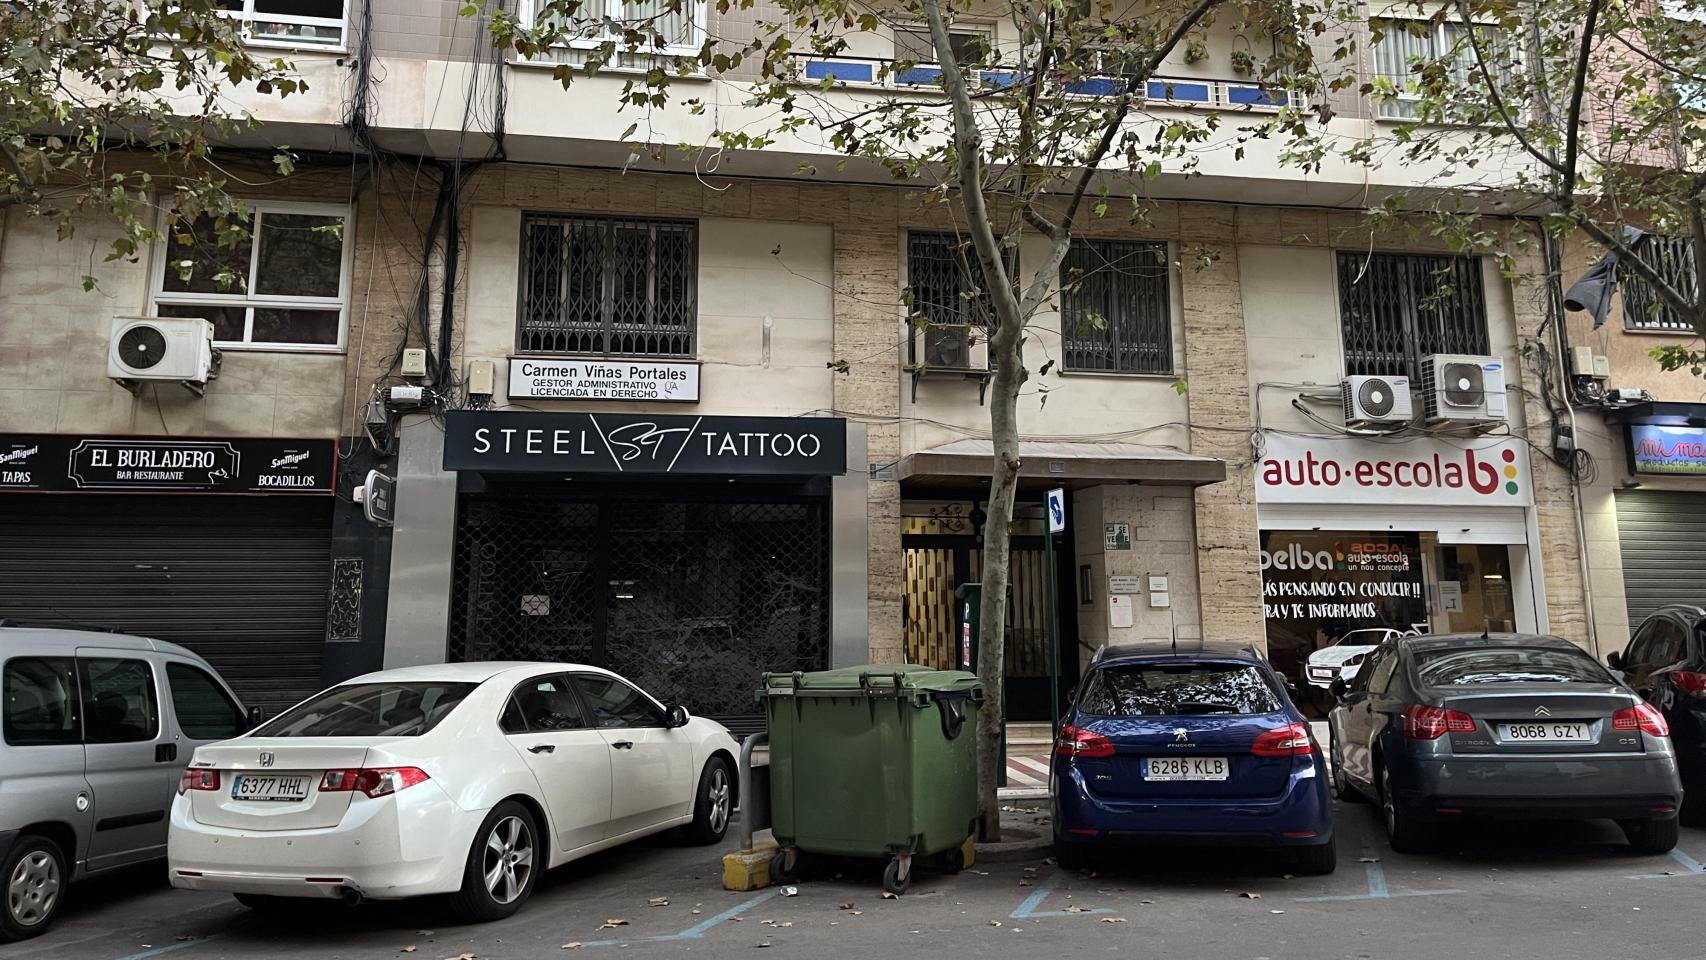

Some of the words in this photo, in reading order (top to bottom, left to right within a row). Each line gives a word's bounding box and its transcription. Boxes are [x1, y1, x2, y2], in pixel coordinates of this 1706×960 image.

[521, 363, 577, 377] Carmen
[584, 365, 622, 379] Viñas
[629, 366, 687, 380] Portales
[532, 379, 573, 388] GESTOR
[577, 380, 656, 390] ADMINISTRATIVO
[530, 388, 589, 397] LICENCIADA
[611, 390, 658, 398] DERECHO
[473, 428, 595, 455] STEEL
[701, 432, 821, 457] TATTOO
[90, 449, 113, 467] EL
[117, 450, 215, 468] BURLADERO
[1, 471, 31, 483] TAPAS
[116, 470, 132, 480] BAR
[133, 471, 184, 480] RESTAURANTE
[258, 474, 315, 487] BOCADILLOS
[1279, 581, 1337, 597] PENSANDO
[1338, 581, 1356, 597] EN
[1360, 581, 1411, 597] CONDUCIR
[1291, 603, 1305, 618] TE
[1308, 602, 1376, 618] INFORMAMOS
[1510, 725, 1546, 738] 8068
[1553, 725, 1583, 738] GZY
[1151, 760, 1189, 774] 6286
[1194, 760, 1223, 774] KLB
[241, 778, 276, 794] 6377
[277, 778, 304, 795] HHL
